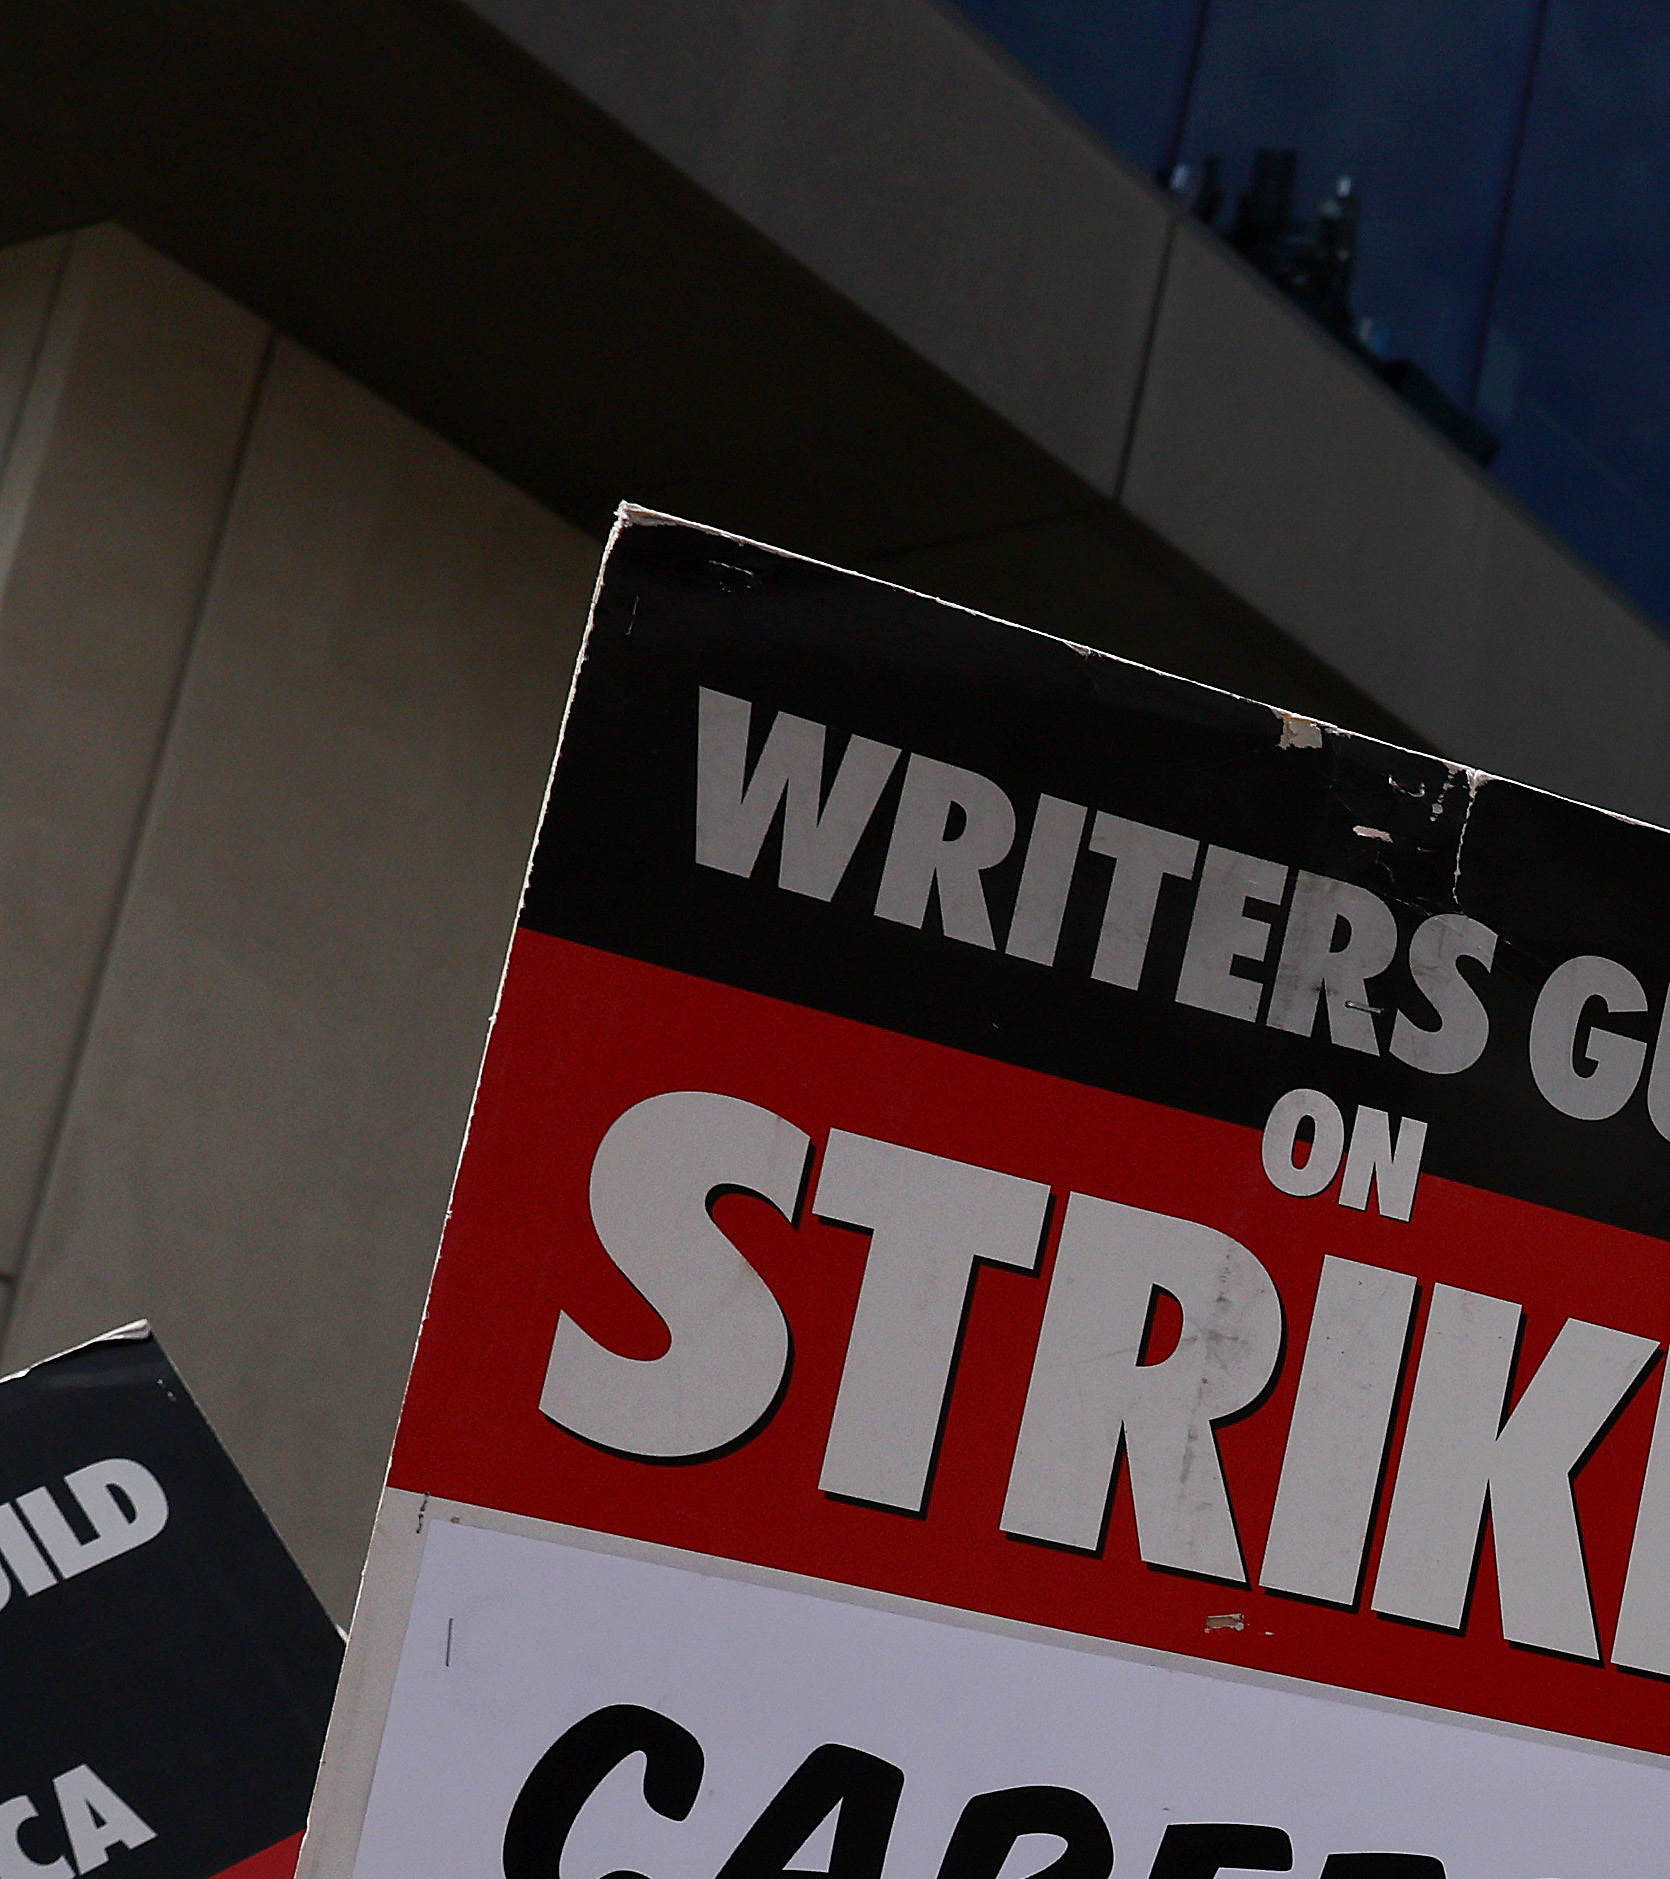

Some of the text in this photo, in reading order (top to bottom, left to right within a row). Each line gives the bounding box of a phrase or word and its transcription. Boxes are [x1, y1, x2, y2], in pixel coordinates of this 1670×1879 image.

[695, 685, 1499, 1075] WRITERS
[1260, 1088, 1429, 1222] ON
[0, 1457, 169, 1609] ILD
